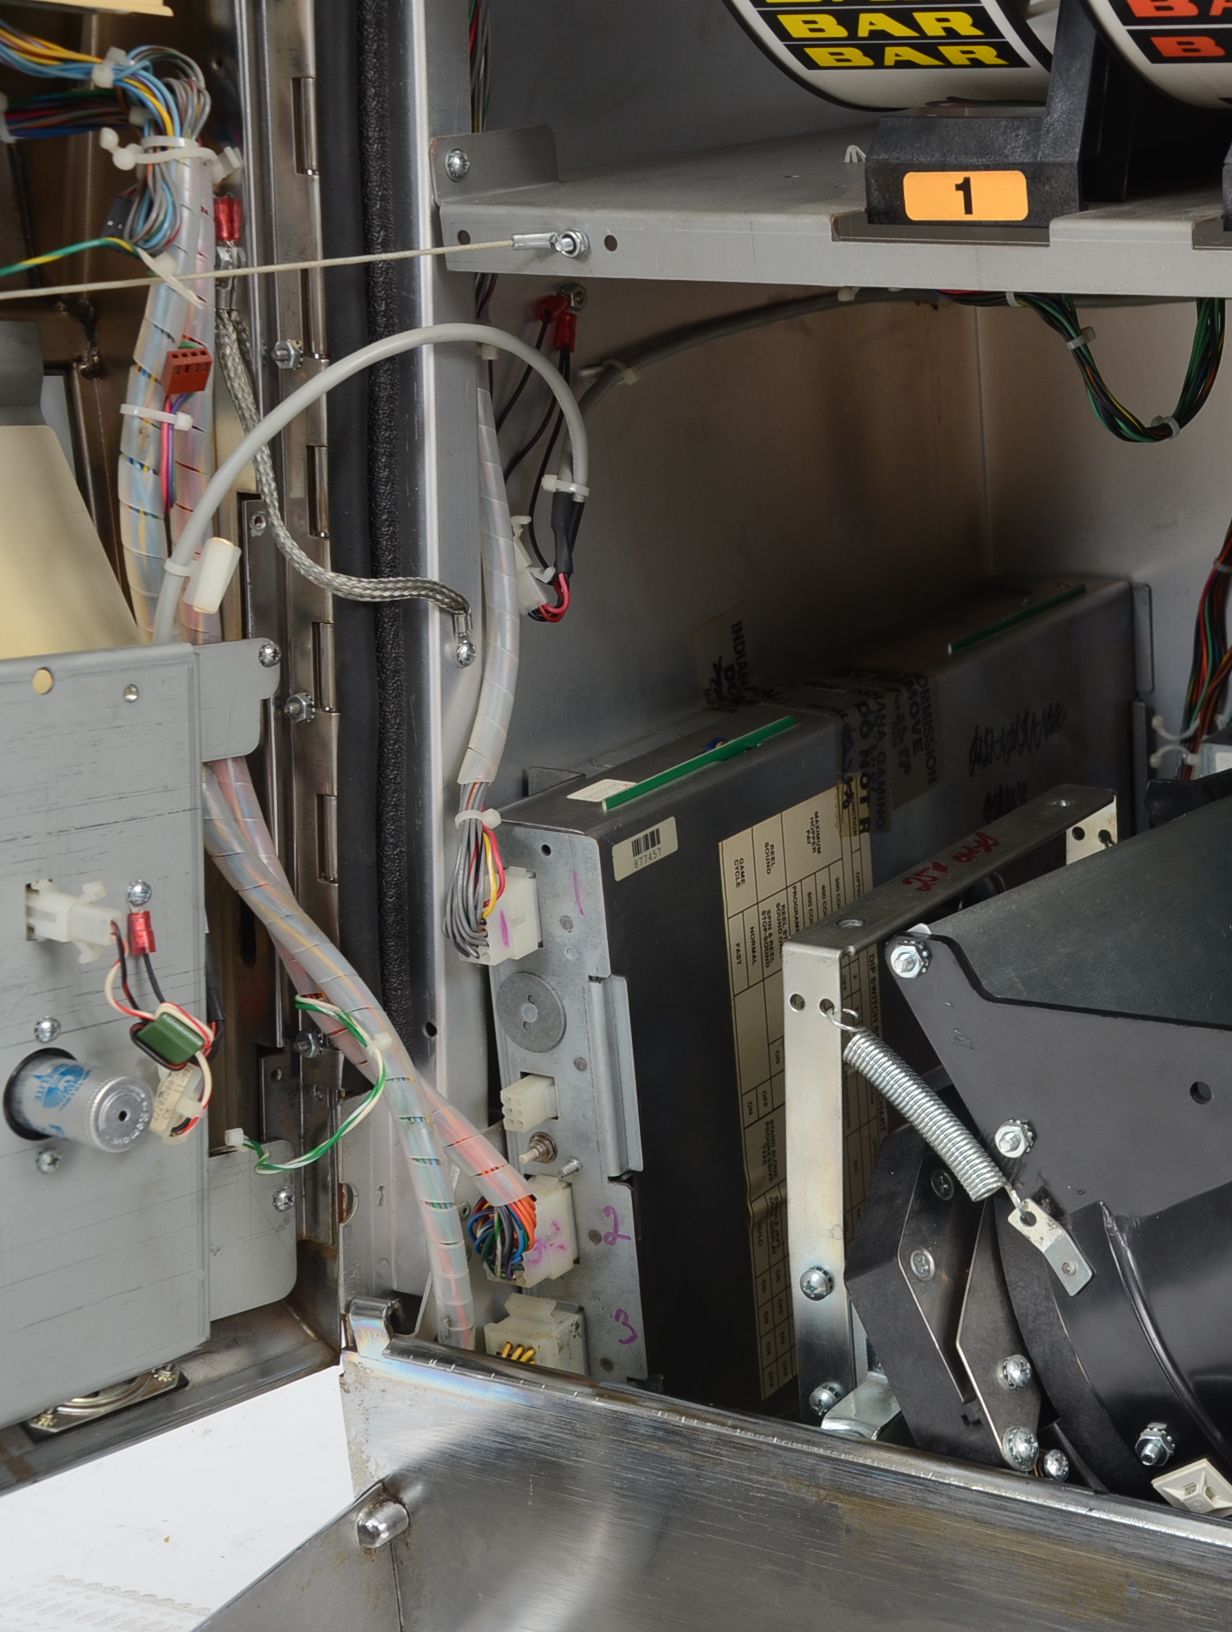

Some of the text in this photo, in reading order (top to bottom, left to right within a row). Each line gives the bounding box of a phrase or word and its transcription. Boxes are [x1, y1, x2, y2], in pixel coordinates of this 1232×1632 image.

[775, 11, 986, 40] BAR
[802, 45, 1009, 67] BAR
[954, 176, 973, 215] 1
[814, 811, 822, 855] MAXIMUM
[764, 842, 772, 875] SOUND
[780, 904, 788, 928] REEL
[735, 942, 743, 965] FAST
[749, 926, 757, 966] NORMAL
[761, 910, 770, 968] STOP-SOUND
[747, 1101, 754, 1115] ON
[602, 1204, 632, 1246] 2
[614, 1308, 638, 1345] 3
